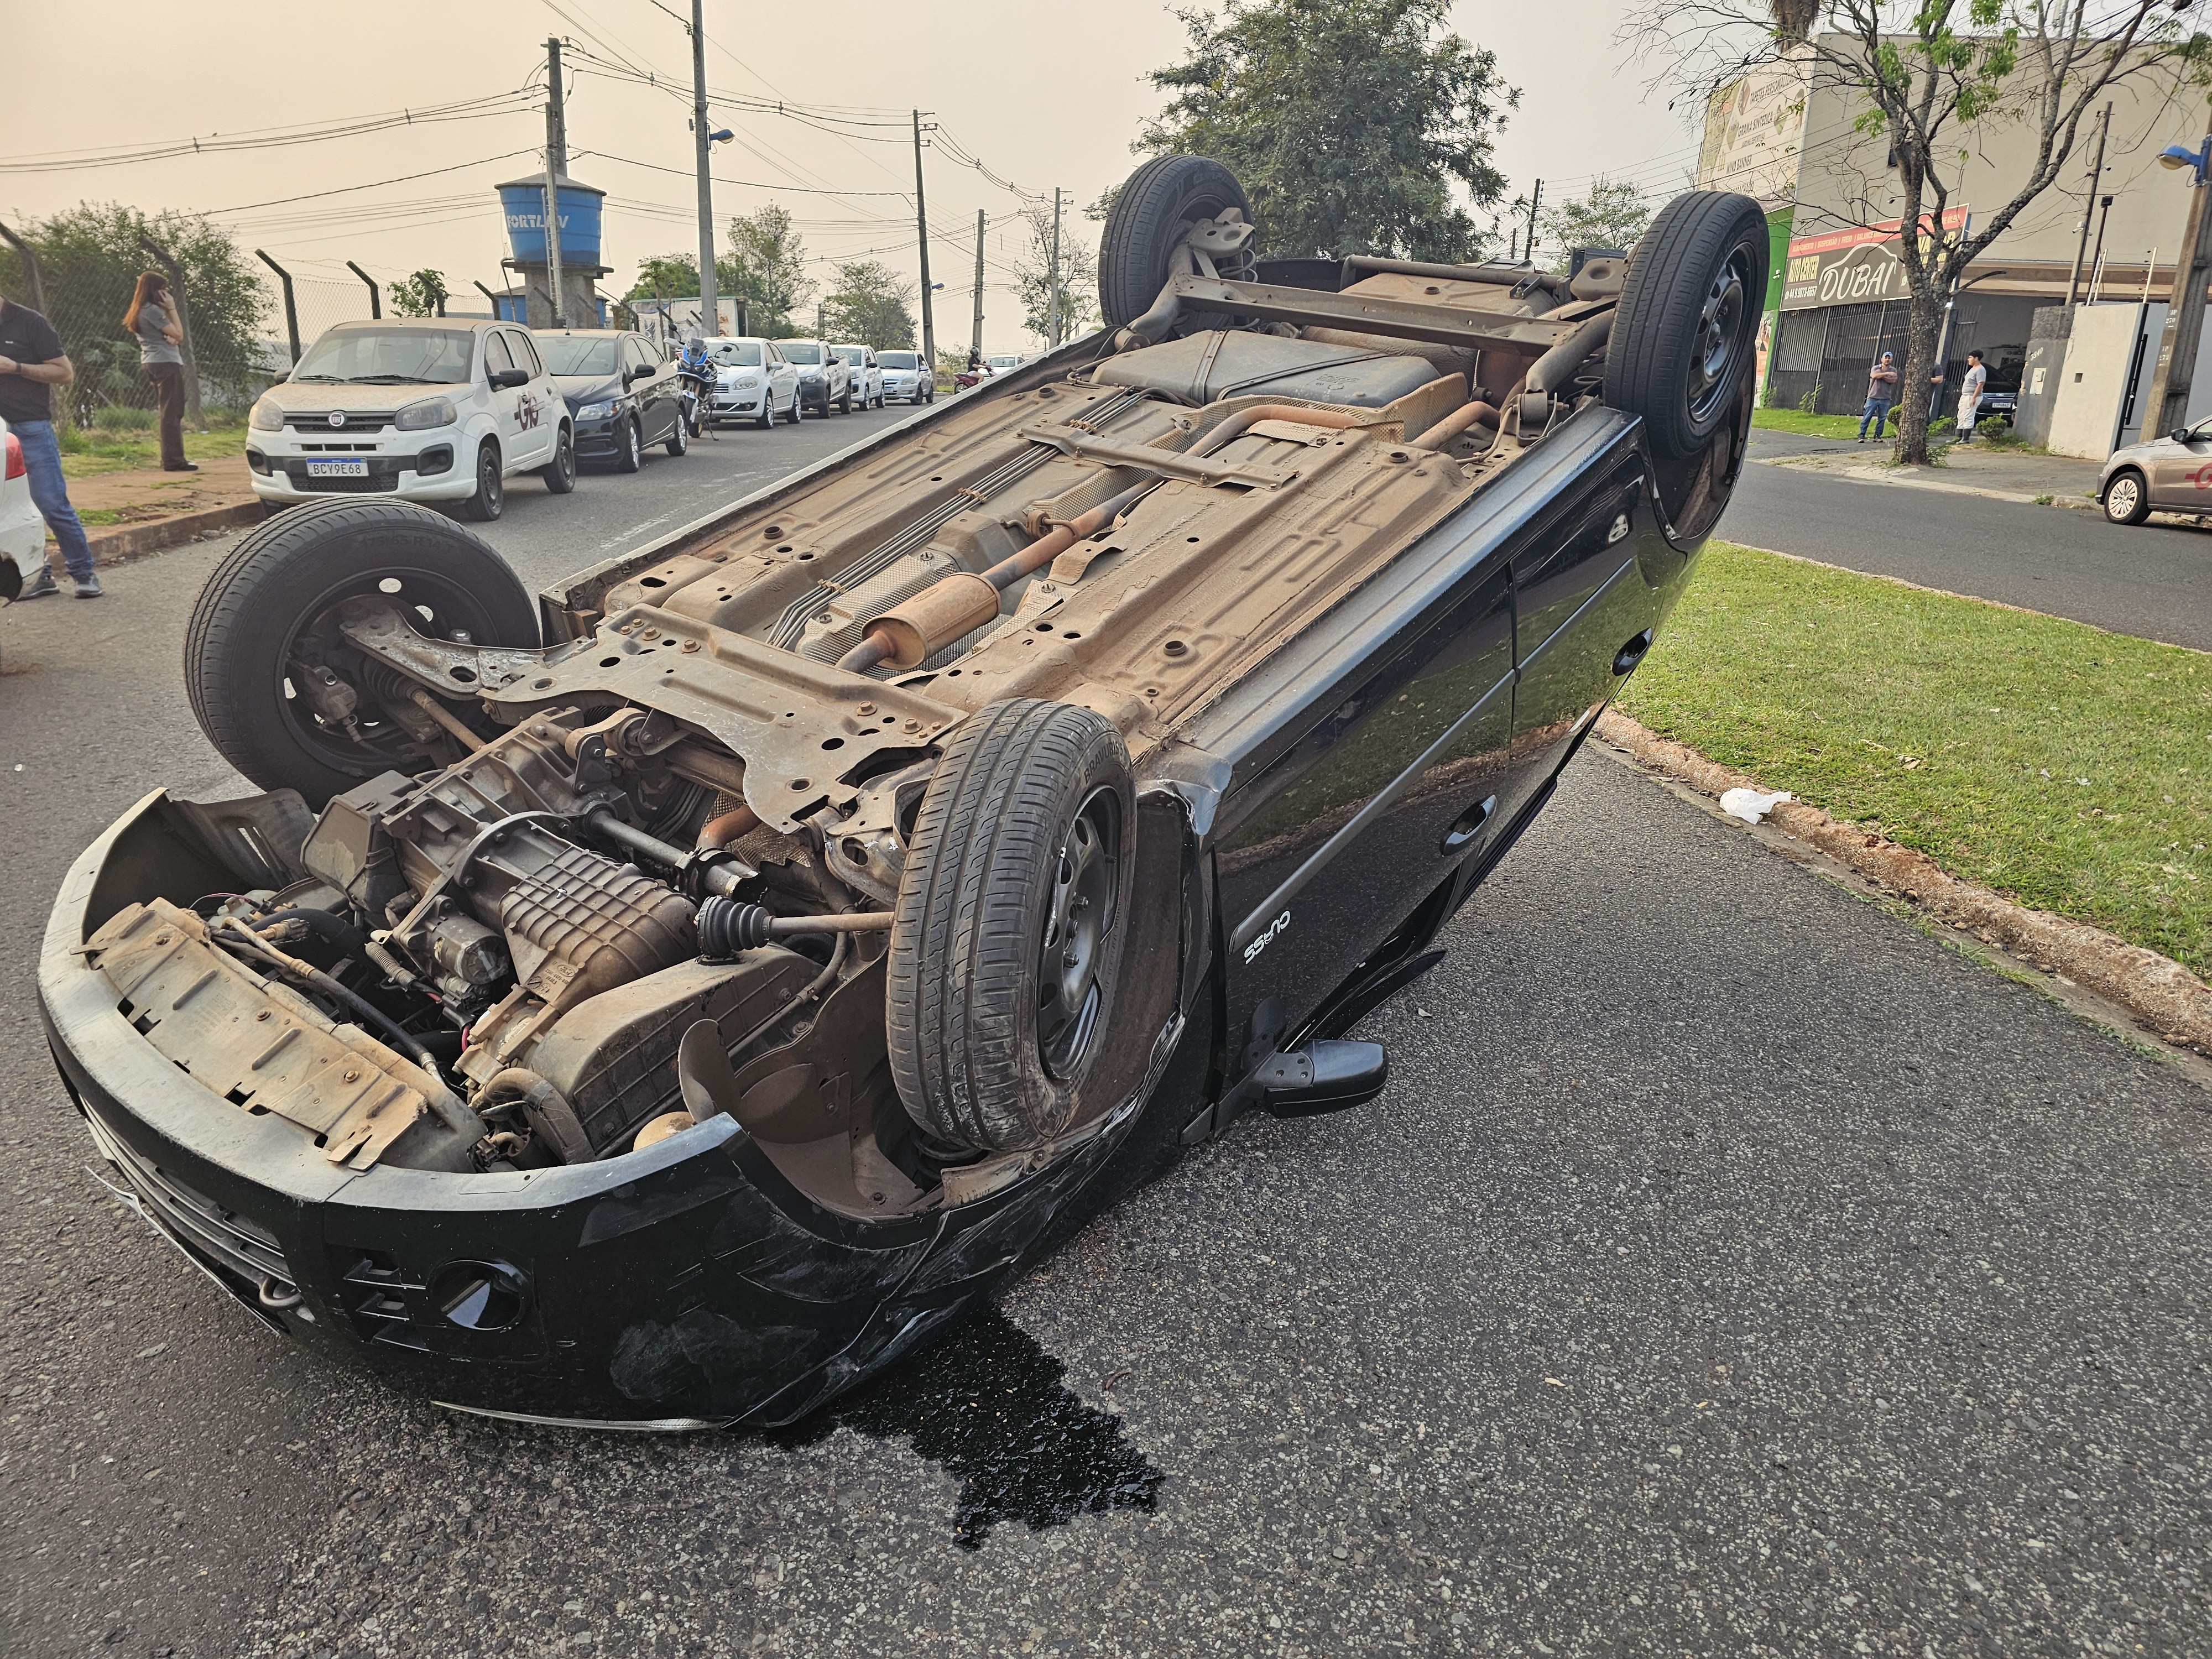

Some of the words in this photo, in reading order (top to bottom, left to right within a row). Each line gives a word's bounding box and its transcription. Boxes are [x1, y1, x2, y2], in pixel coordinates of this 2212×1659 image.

[1738, 121, 1752, 137] GRAMA
[1726, 160, 1736, 175] WIND
[1737, 154, 1752, 170] BANNER
[507, 214, 569, 228] FORTLV
[1817, 236, 1838, 248] SUSPENSÃO
[1841, 235, 1853, 244] FREIO
[1787, 258, 1802, 283] AUTO
[1800, 255, 1820, 281] CENTER
[1820, 261, 1895, 301] DUBAI
[313, 464, 361, 474] BCY9E68
[1084, 741, 1119, 785] BRAVURIS
[1244, 910, 1291, 964] CLASS
